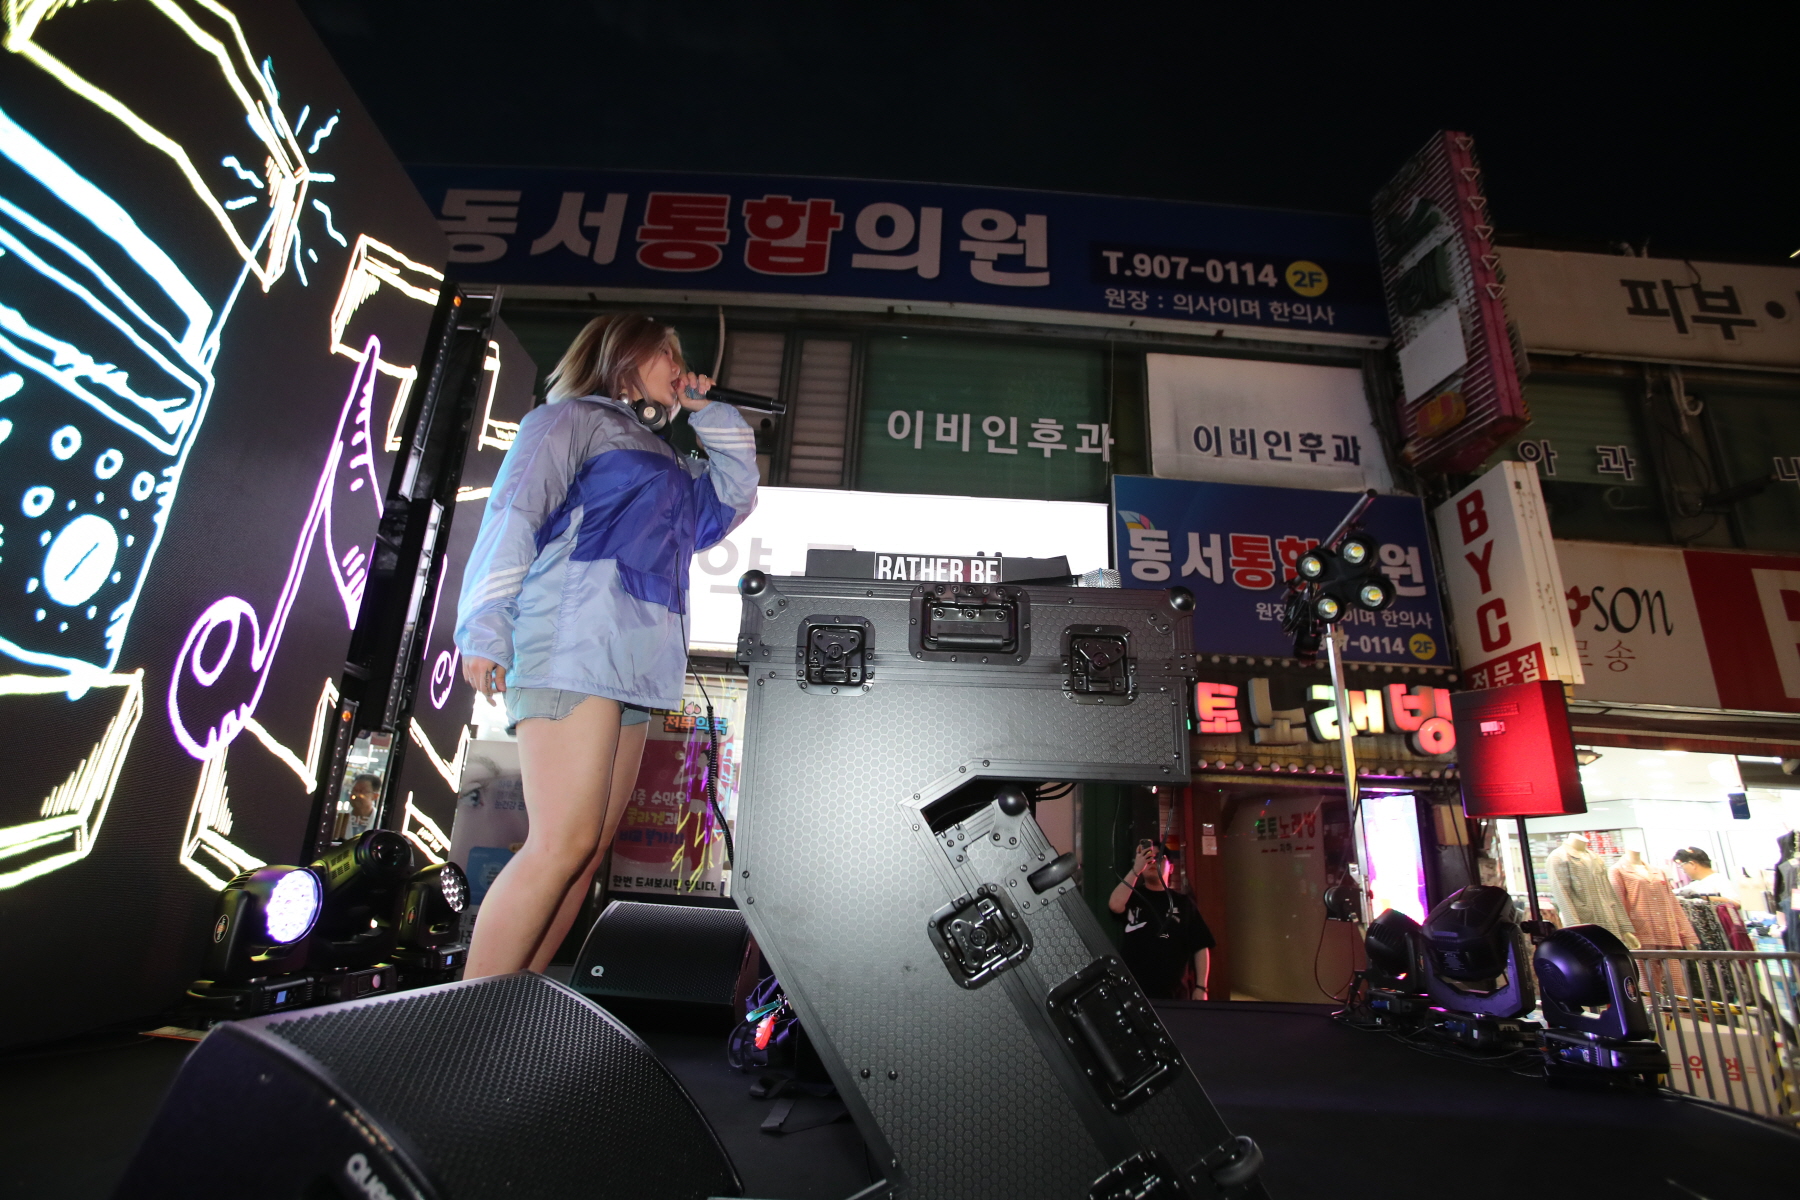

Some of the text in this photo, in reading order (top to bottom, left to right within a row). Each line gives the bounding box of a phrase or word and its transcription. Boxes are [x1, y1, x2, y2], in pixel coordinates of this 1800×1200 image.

[437, 188, 1050, 287] 동서통합의원
[1102, 251, 1323, 289] T.907-0114 2F
[1104, 288, 1149, 310] 원장
[1173, 293, 1261, 320] 의사이며
[1269, 301, 1336, 326] 한의사
[887, 410, 1115, 462] 이비인후과
[1193, 425, 1361, 466] 이비인후과
[878, 554, 998, 583] RATHER BE
[1129, 529, 1427, 597] 동서통합원
[1456, 489, 1512, 653] BYC
[1382, 608, 1433, 630] 한의사
[1413, 641, 1433, 653] 2F
